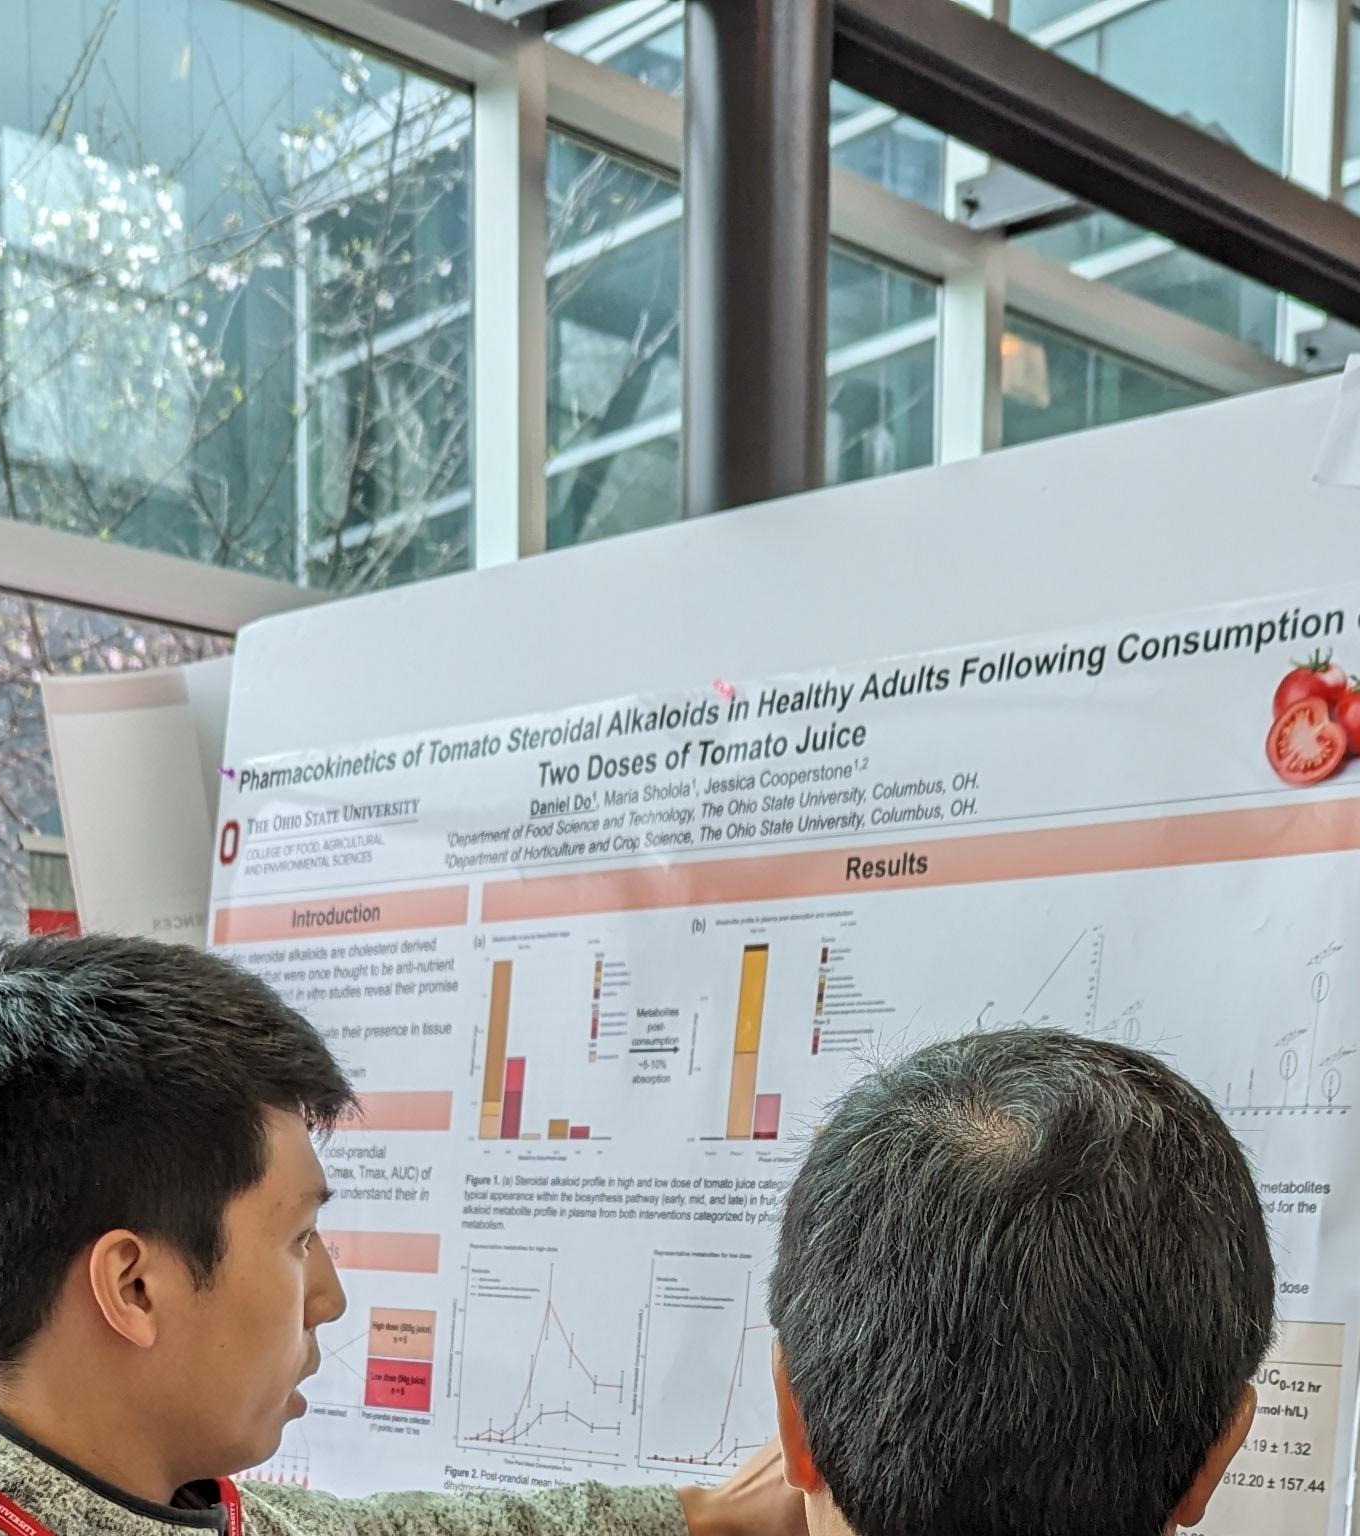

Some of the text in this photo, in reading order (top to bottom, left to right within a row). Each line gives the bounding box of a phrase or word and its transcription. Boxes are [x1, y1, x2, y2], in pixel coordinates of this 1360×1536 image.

[239, 750, 396, 793] Pharmacokinetics
[403, 744, 424, 768] of
[430, 734, 501, 765] Tomato
[507, 714, 601, 753] Steroidal
[607, 699, 719, 738] Alkaloids
[728, 696, 749, 722] in
[758, 681, 854, 718] Healthy
[860, 664, 949, 702] Adults
[960, 644, 1106, 687] Following
[1118, 607, 1344, 654] Consumption
[539, 722, 866, 787] Two Doses of Tomato Juice
[531, 771, 755, 817] Daniel Maria Jessica
[343, 798, 420, 822] UNIVERSITY
[512, 772, 980, 839] of Food Science and Technology, The Ohio State University, Columbus, OH.
[511, 798, 978, 861] of Horticulture and Crop Science, The Ohio State University, Columbus, OH.
[845, 852, 928, 880] Results
[292, 904, 380, 928] Introduction
[692, 919, 706, 936] (b)
[288, 937, 437, 962] alkaloids are cholesterol derived
[474, 934, 486, 950] (a)
[309, 969, 331, 981] once
[334, 964, 368, 981] thought
[371, 965, 379, 977] to
[382, 962, 393, 976] be
[396, 958, 454, 975] anti-nutrient
[328, 979, 459, 999] studies reveal their promise
[342, 1024, 362, 1038] their
[364, 1024, 408, 1041] presence
[411, 1023, 419, 1035] in
[422, 1022, 452, 1035] tissue
[632, 1037, 680, 1049] consumption
[632, 1075, 671, 1086] absorption
[325, 1146, 386, 1161] post-prandial
[391, 1166, 419, 1182] AUC)
[422, 1166, 432, 1180] of
[466, 1175, 756, 1191] Figure Steroidal alkaloid profile in high and low dose of tomato juice
[341, 1188, 429, 1201] understand their in
[1260, 1181, 1331, 1195] metabolites
[464, 1190, 488, 1202] typical
[490, 1192, 534, 1202] appearance
[537, 1191, 558, 1201] within
[560, 1192, 572, 1201] the
[575, 1192, 623, 1205] biosynthesis
[625, 1193, 659, 1206] pathway
[709, 1195, 726, 1205] and
[728, 1195, 747, 1207] late)
[749, 1195, 757, 1205] in
[1277, 1201, 1317, 1214] for the
[493, 1206, 532, 1216] metabolite
[533, 1206, 558, 1218] profile
[559, 1207, 566, 1217] in
[568, 1208, 597, 1219] plasma
[599, 1208, 617, 1218] from
[619, 1209, 636, 1218] both
[639, 1210, 691, 1221] interventions
[693, 1211, 743, 1223] categorized
[745, 1212, 756, 1224] by
[1279, 1282, 1310, 1295] dose
[1282, 1442, 1311, 1456] 1.32
[445, 1465, 529, 1485] Figure Post-prandial
[1223, 1472, 1325, 1493] 812.20 157.44
